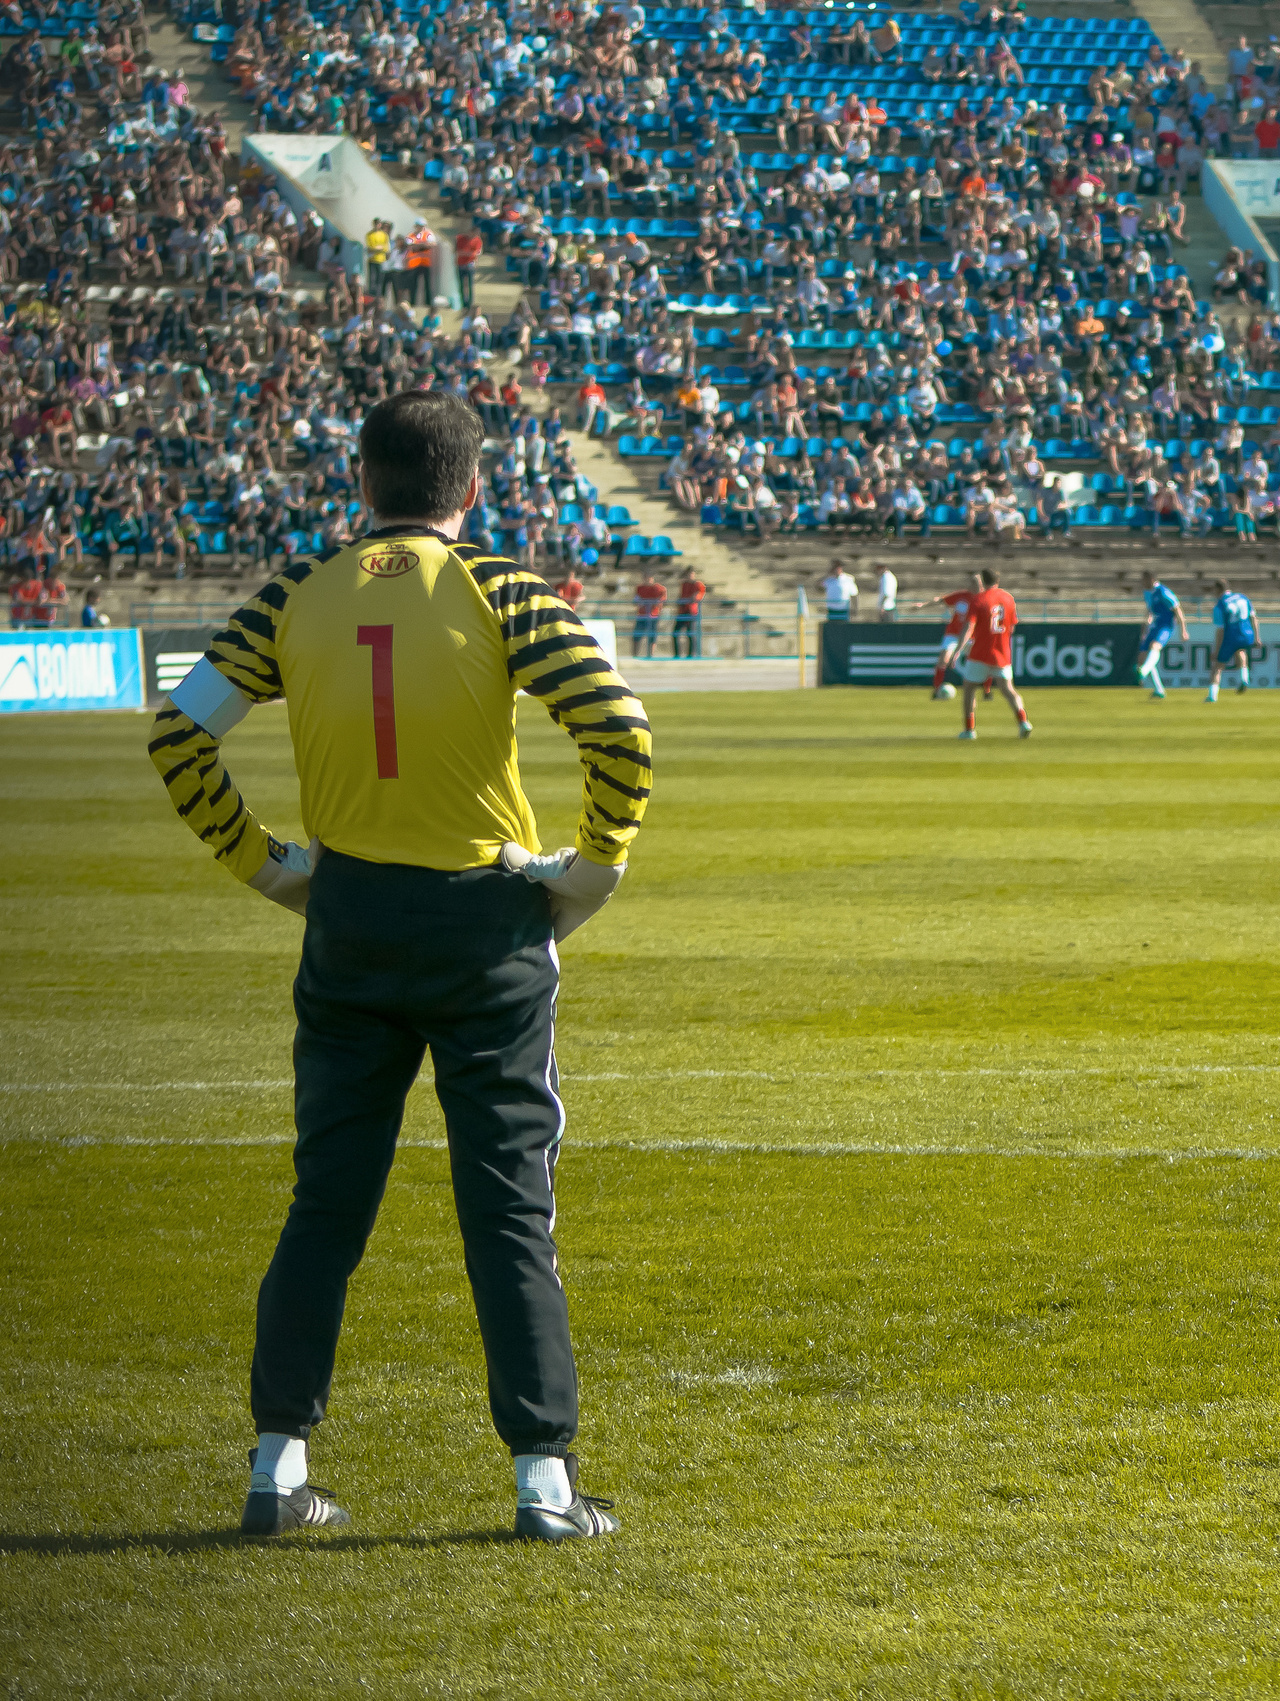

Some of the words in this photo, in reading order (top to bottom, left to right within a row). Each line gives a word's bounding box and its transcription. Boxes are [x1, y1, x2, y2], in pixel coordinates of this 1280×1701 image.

[370, 556, 409, 571] KIA
[990, 604, 1006, 634] 2
[954, 635, 1113, 678] idas
[356, 624, 399, 779] 1
